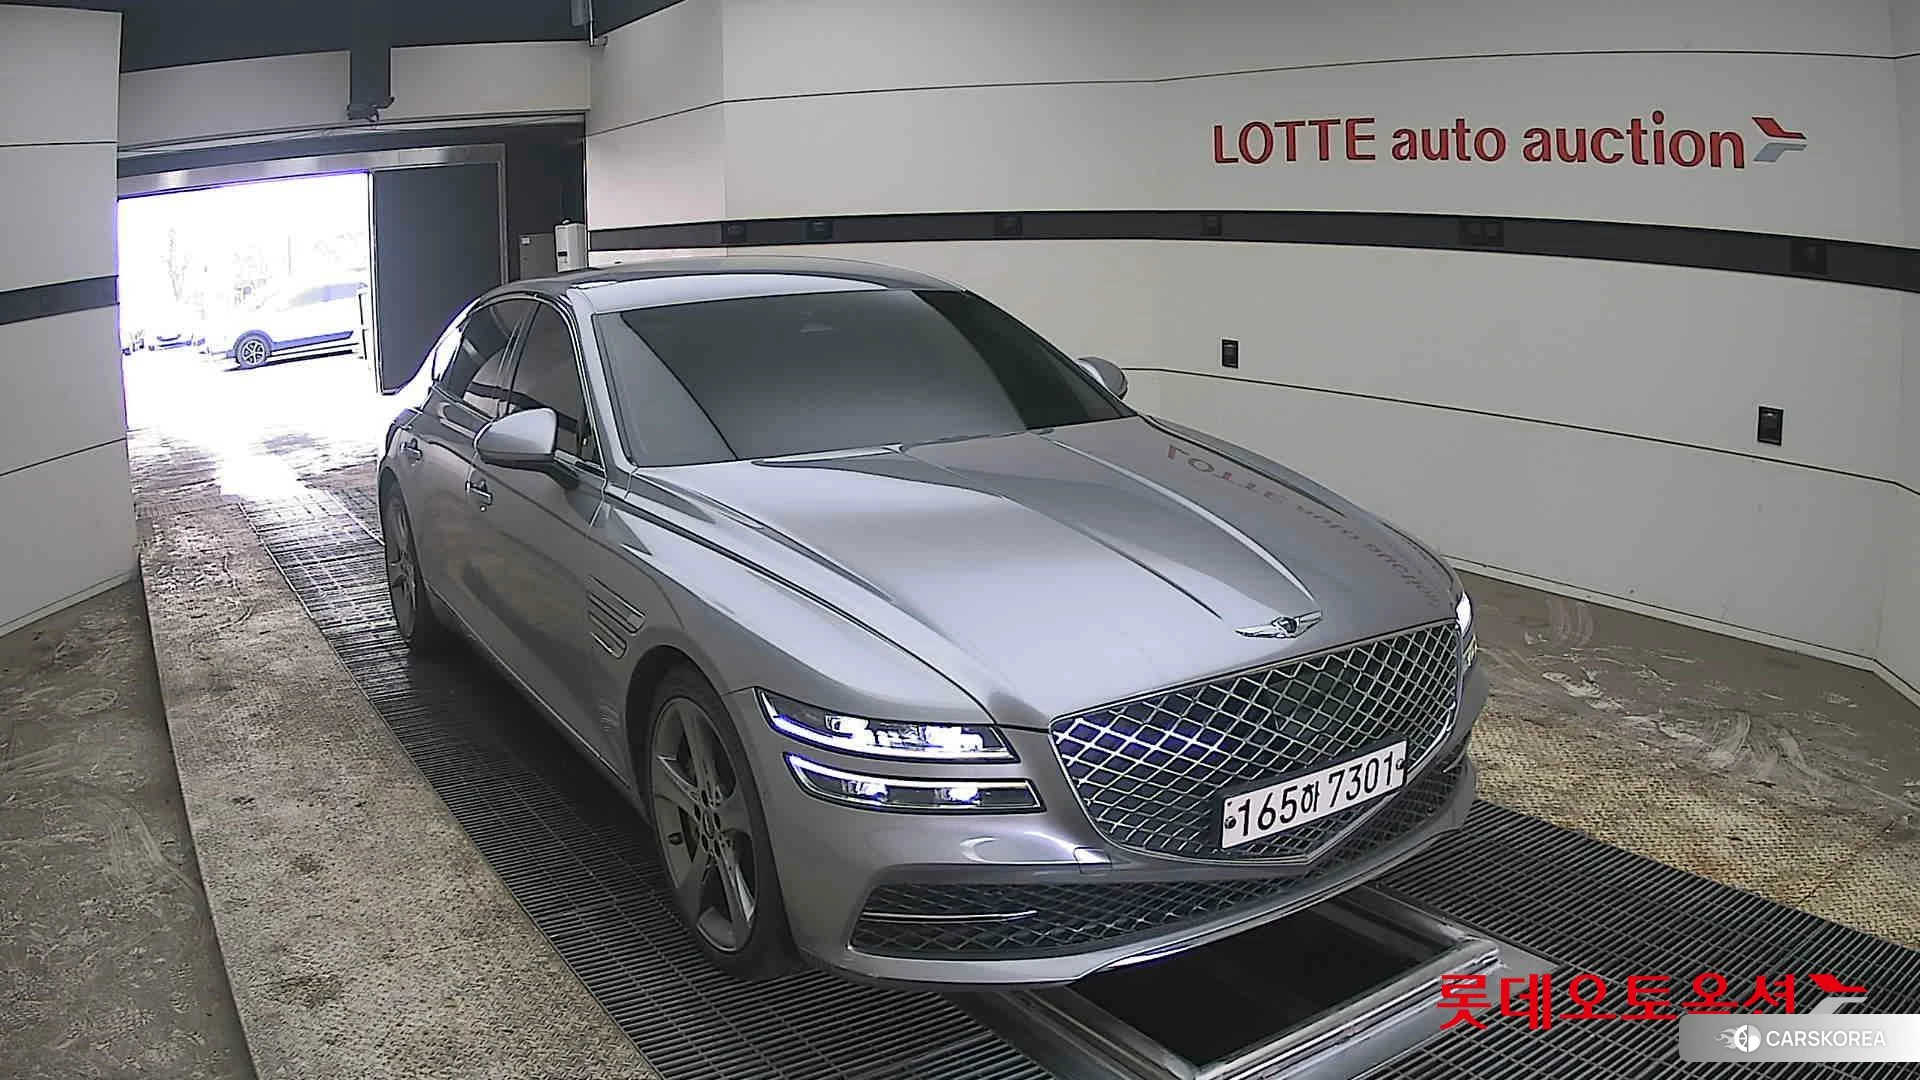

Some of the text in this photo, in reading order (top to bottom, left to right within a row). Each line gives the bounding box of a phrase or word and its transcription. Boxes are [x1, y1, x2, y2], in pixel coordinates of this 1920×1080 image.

[1213, 110, 1744, 168] LOTTE auto auction
[1237, 752, 1394, 836] 165하 7301
